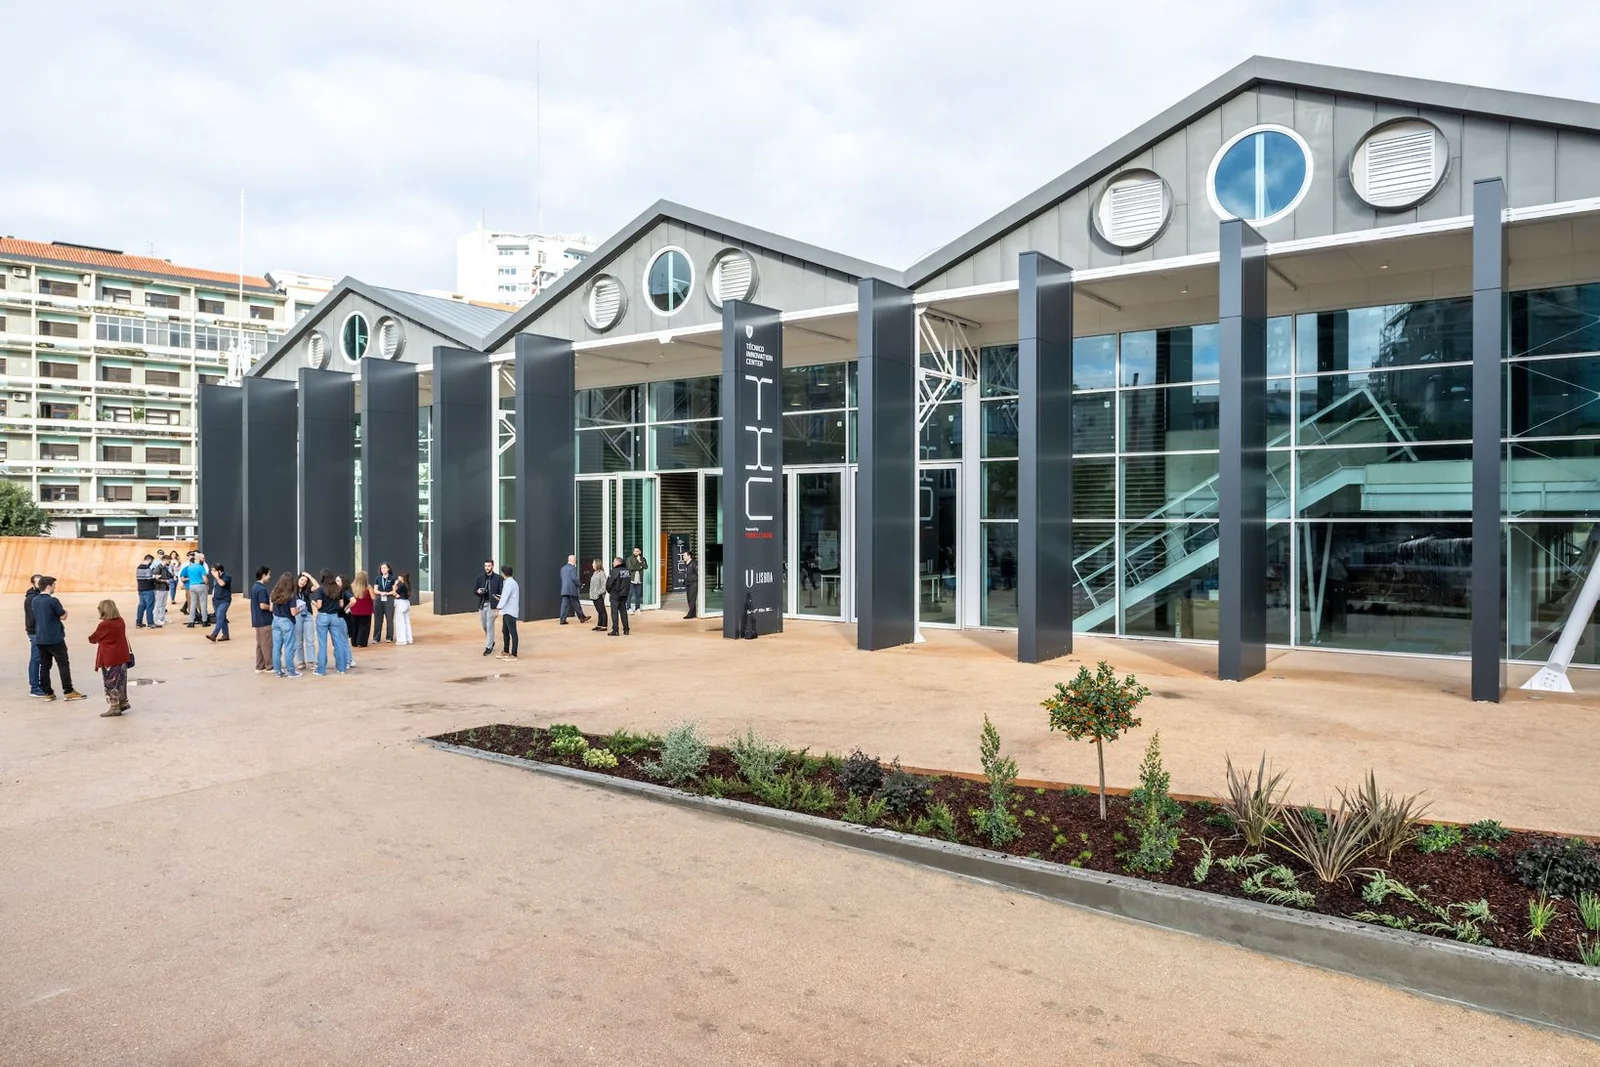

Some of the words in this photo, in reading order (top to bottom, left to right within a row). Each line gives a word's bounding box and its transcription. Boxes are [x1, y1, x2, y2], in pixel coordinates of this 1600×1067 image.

[746, 351, 773, 361] INNOVATION
[746, 358, 763, 367] CENTER
[746, 569, 753, 587] U
[756, 572, 773, 583] LISBOA
